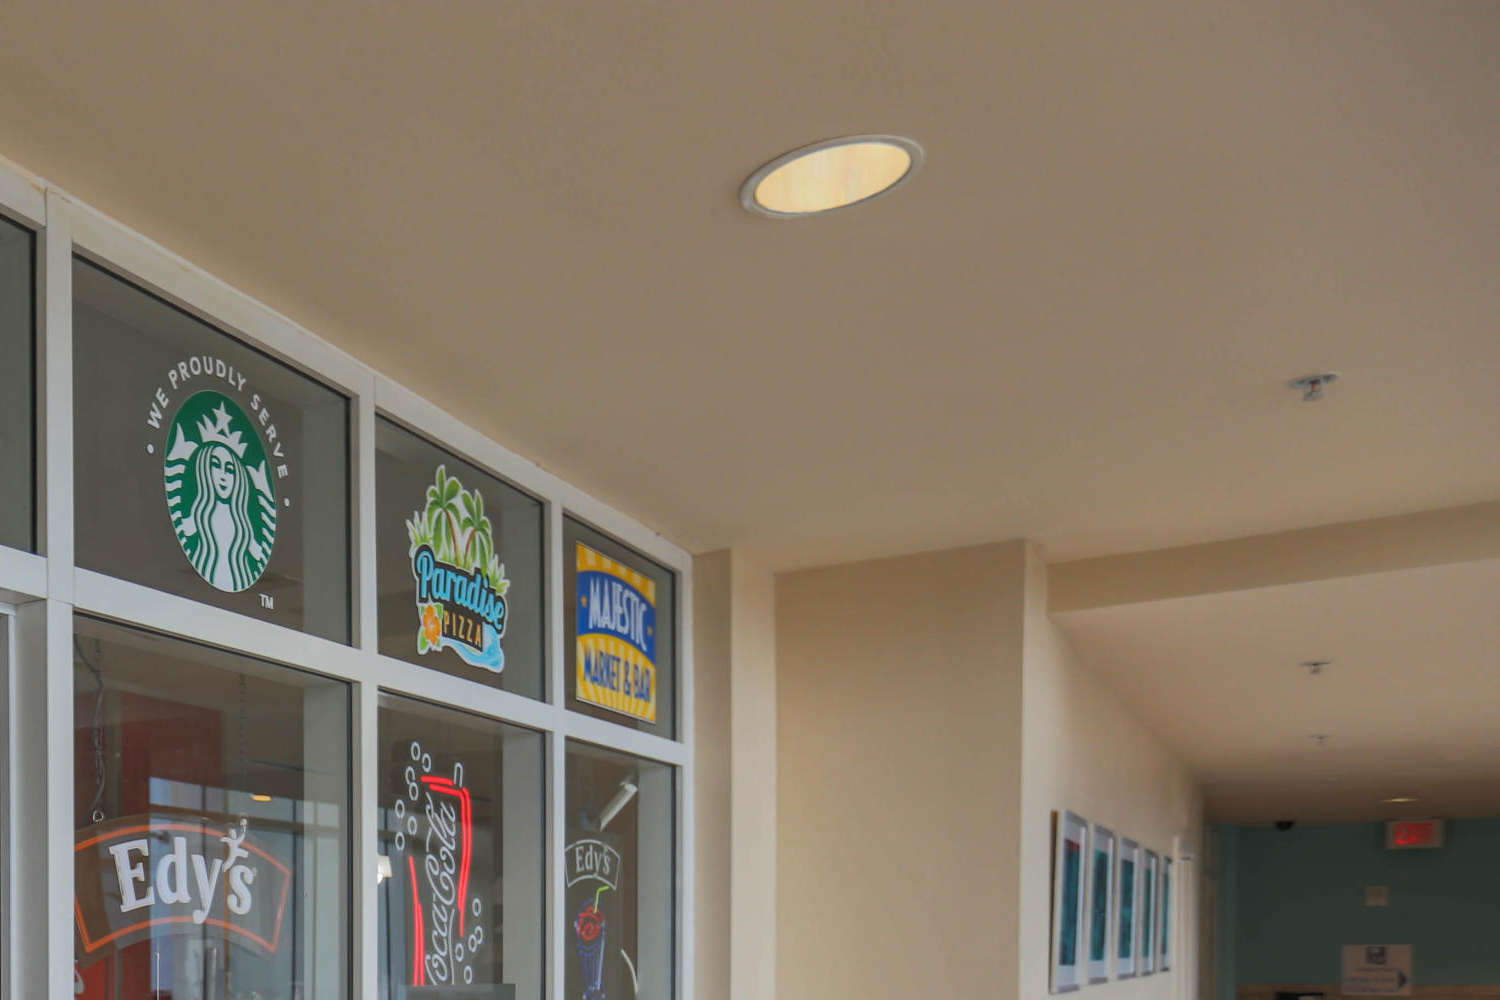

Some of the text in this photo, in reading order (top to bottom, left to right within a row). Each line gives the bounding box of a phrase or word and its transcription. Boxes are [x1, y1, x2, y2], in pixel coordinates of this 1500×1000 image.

[147, 355, 289, 479] WE PROUDLY SERVE
[260, 594, 274, 609] TM
[416, 550, 505, 630] Paradise
[588, 577, 648, 652] MAJESTIC
[443, 610, 483, 647] PIZZA
[583, 648, 651, 703] MARKET & BAR
[109, 828, 254, 924] Edy's
[575, 843, 611, 876] Edy's
